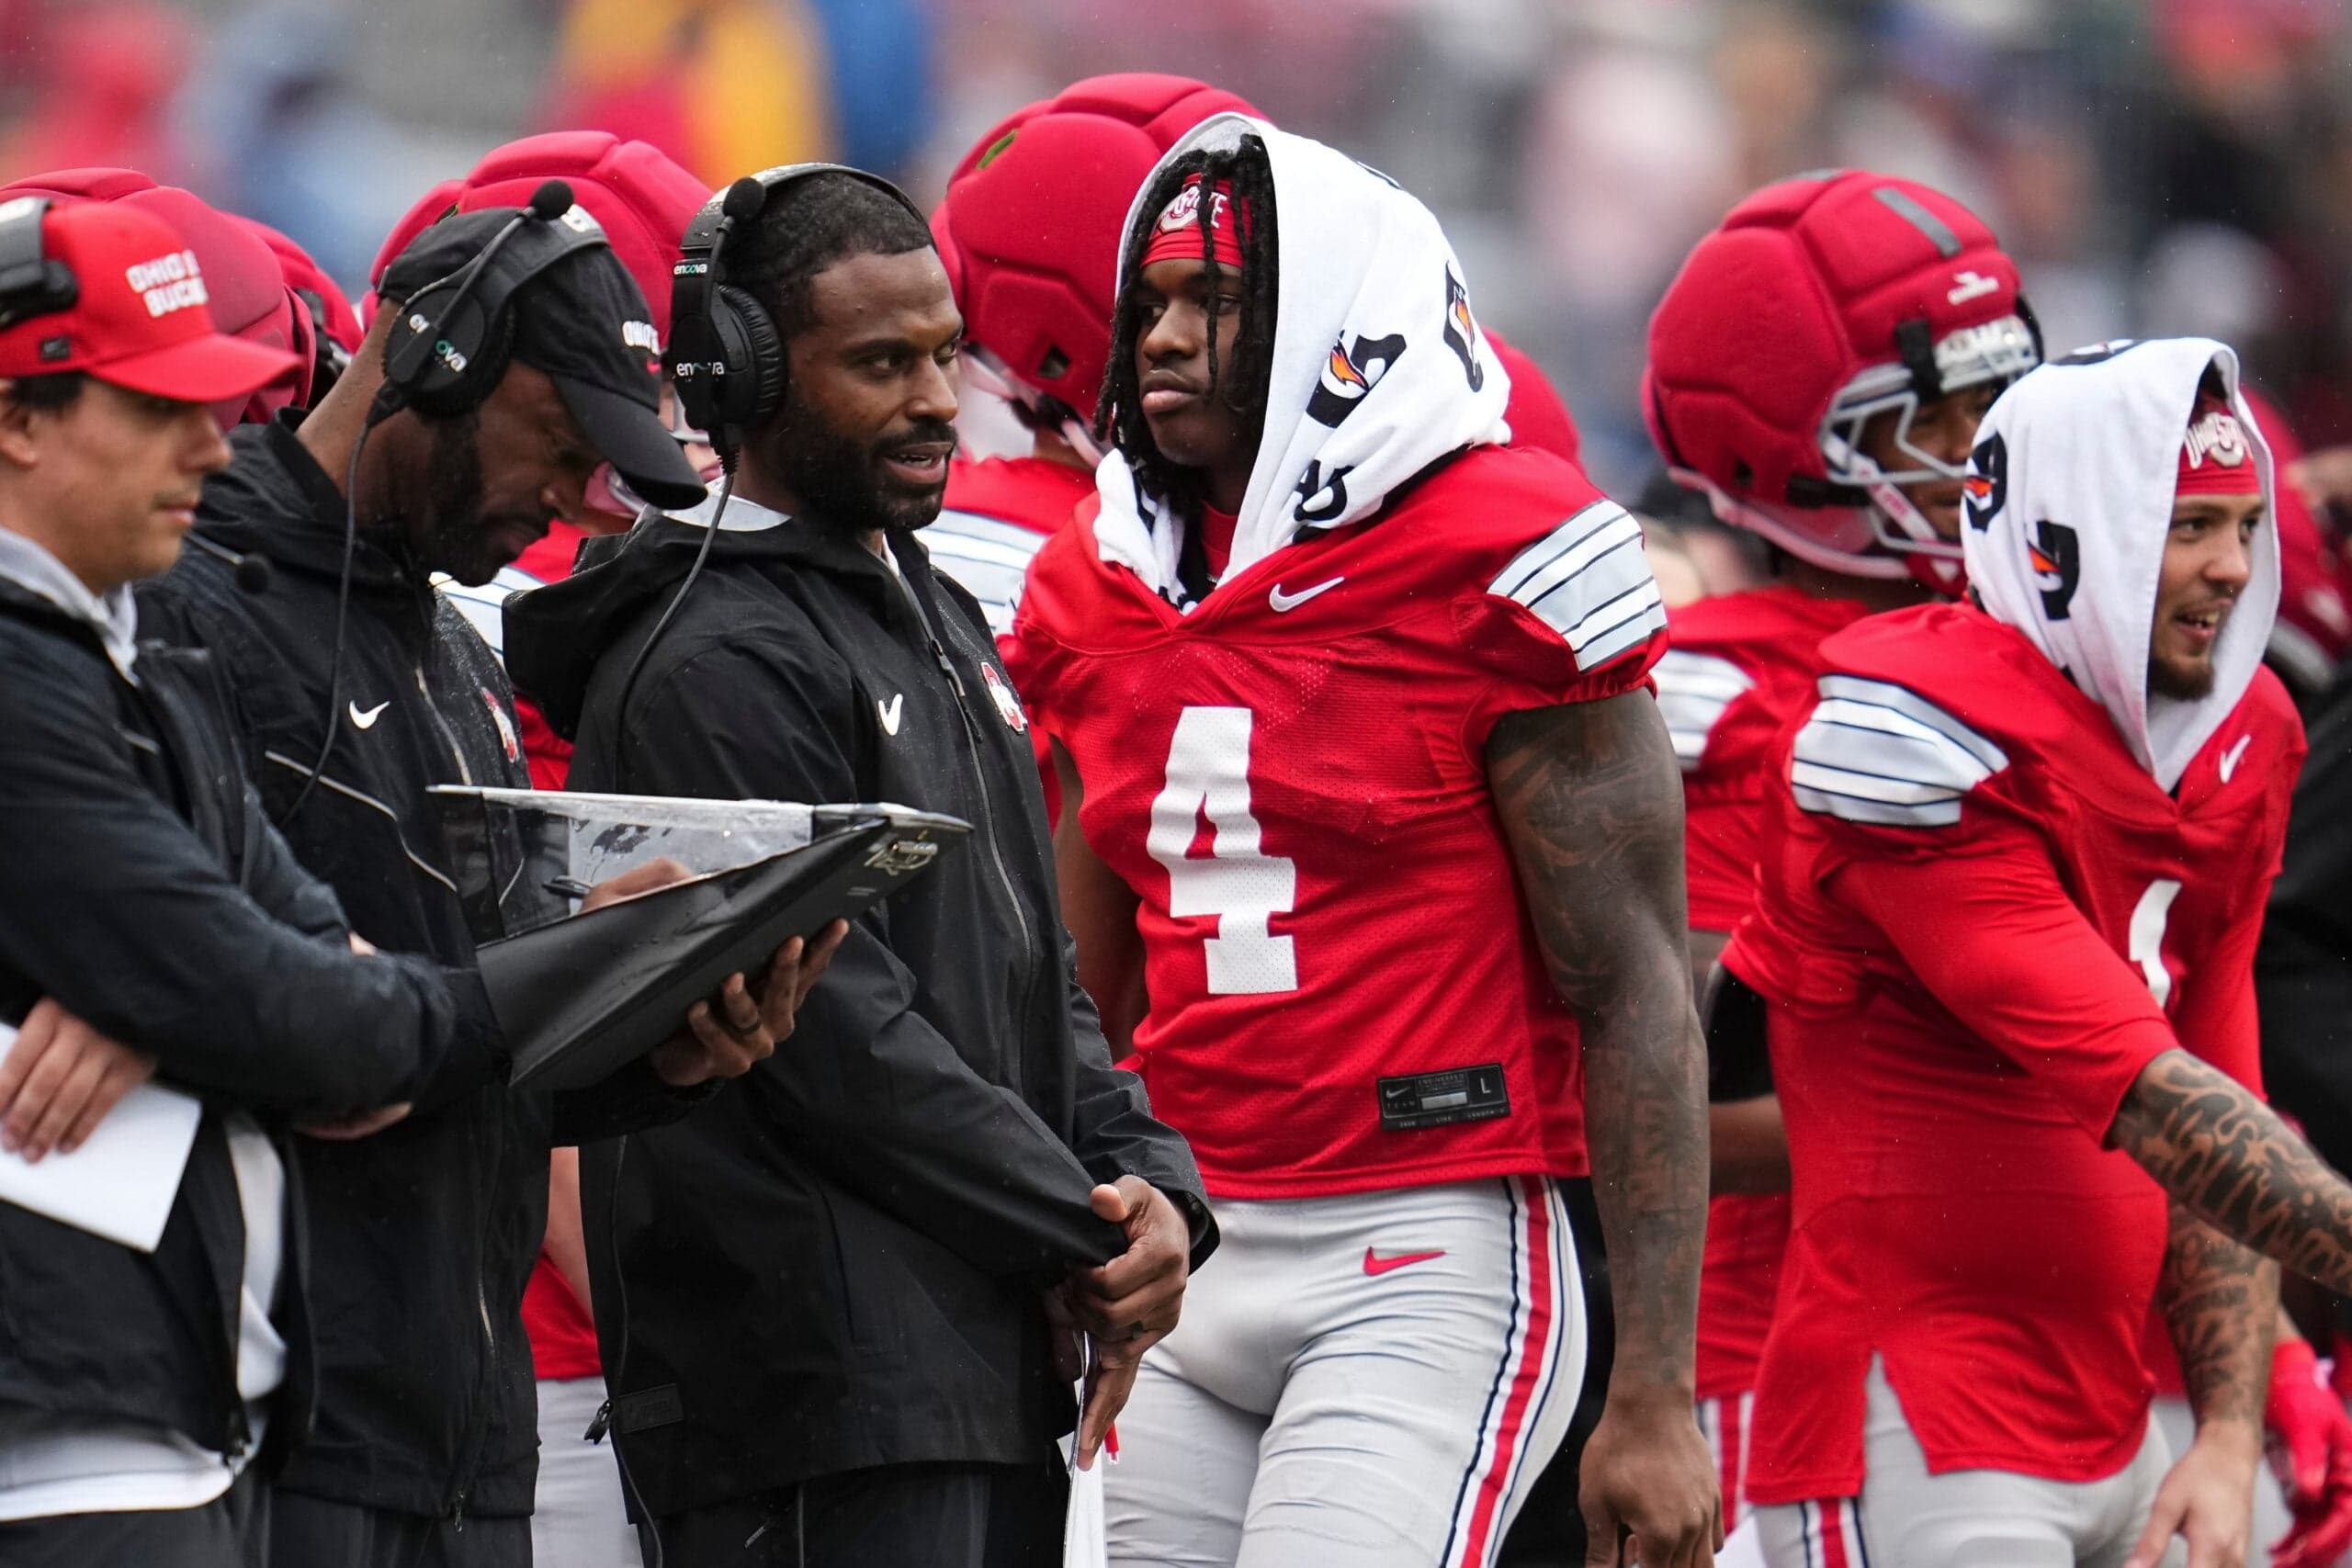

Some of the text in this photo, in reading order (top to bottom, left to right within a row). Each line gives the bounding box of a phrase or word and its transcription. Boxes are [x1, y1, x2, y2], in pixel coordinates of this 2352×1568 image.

[1147, 706, 1297, 994] 4
[2129, 879, 2182, 1010] 1
[1480, 1077, 1492, 1094] L
